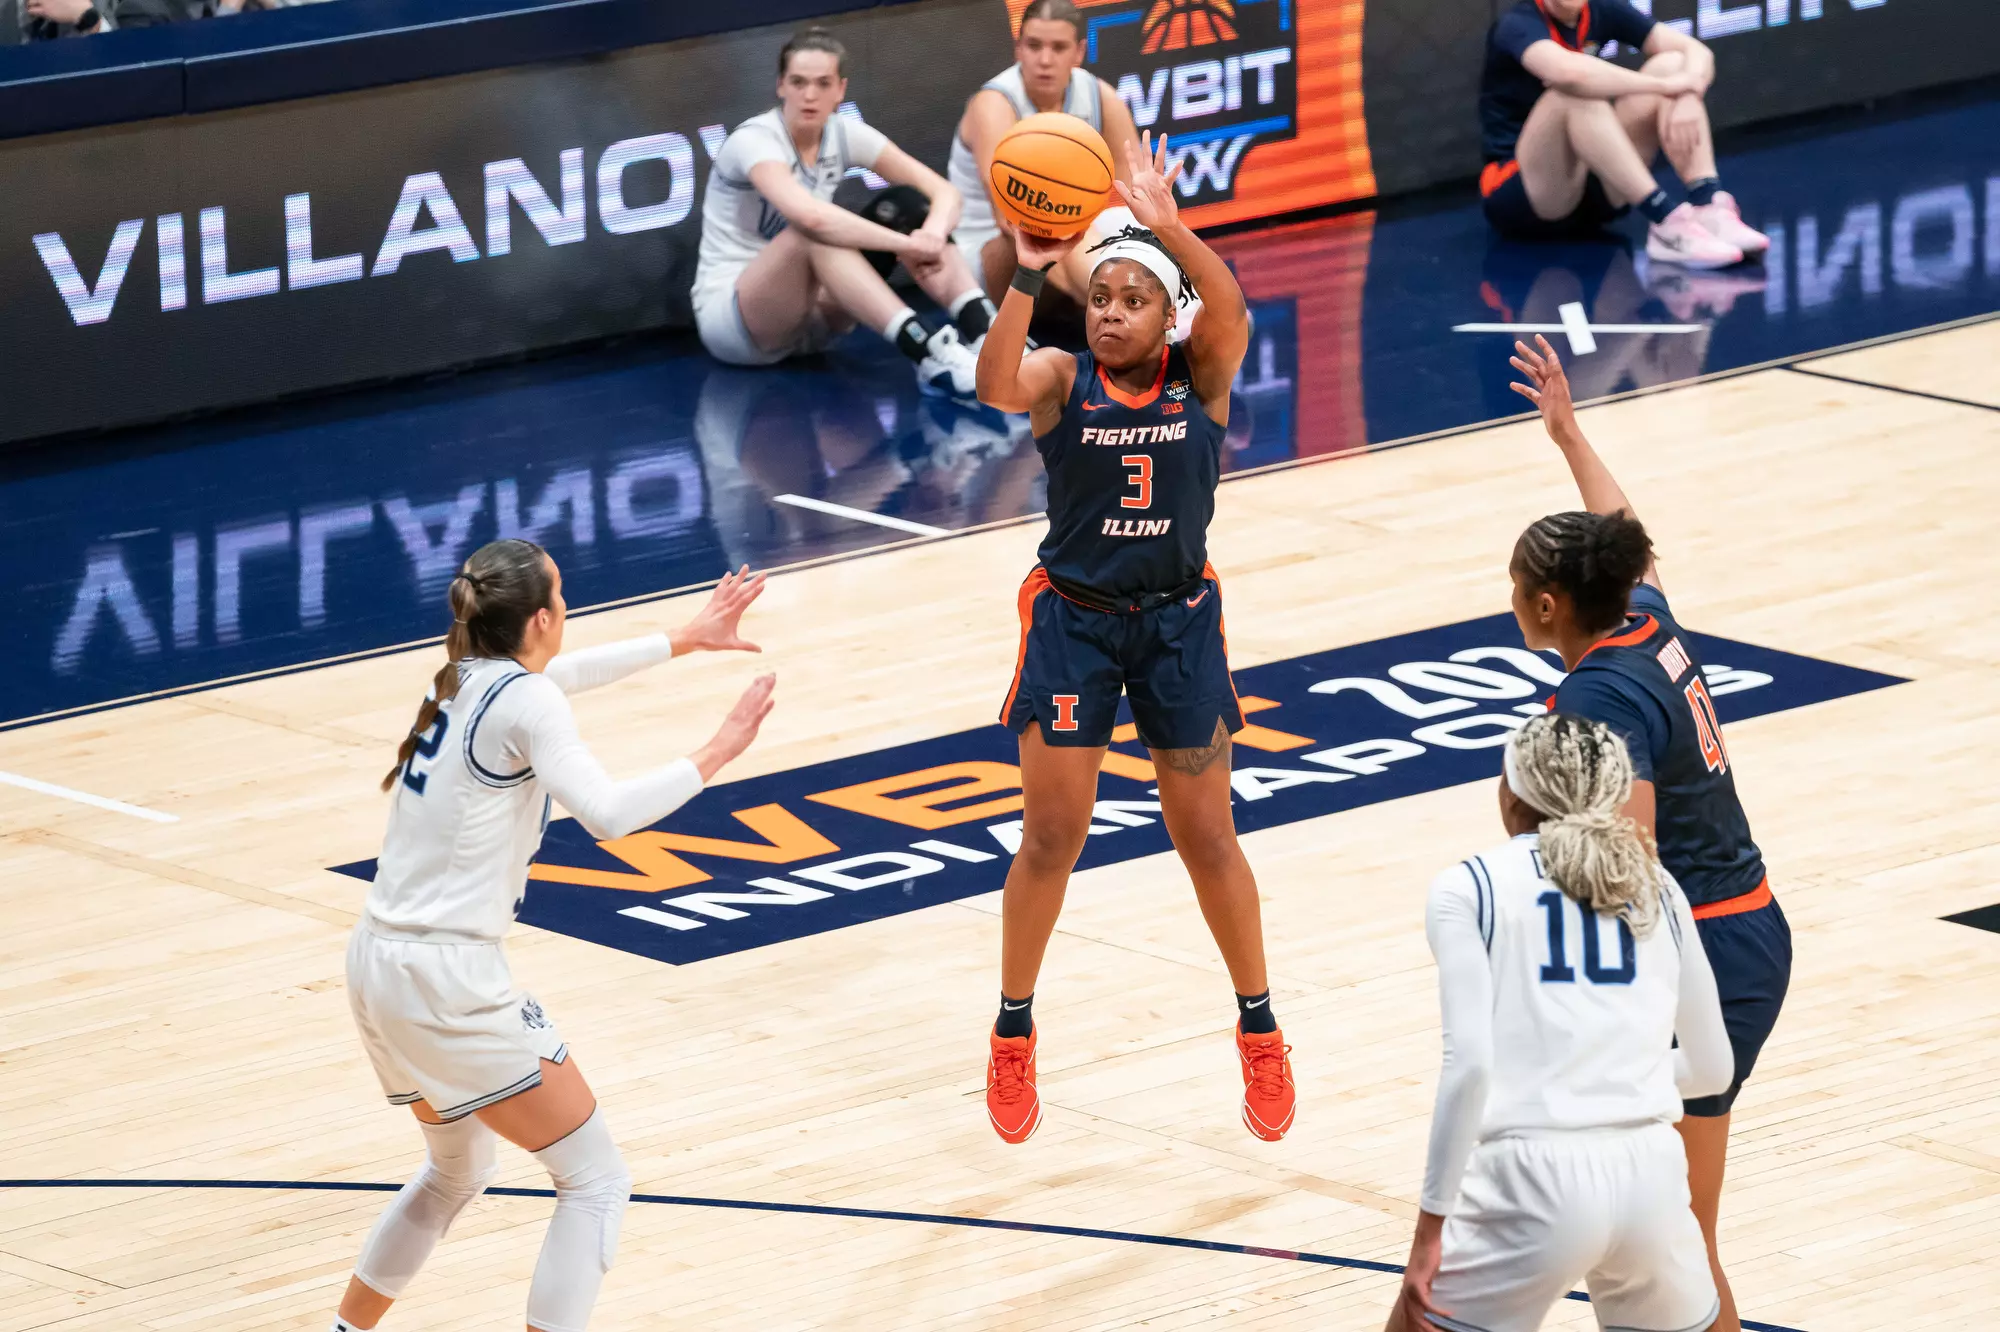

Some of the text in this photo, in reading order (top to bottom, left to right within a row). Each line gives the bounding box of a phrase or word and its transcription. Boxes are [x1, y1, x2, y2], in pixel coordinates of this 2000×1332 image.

[1117, 47, 1292, 126] WBIT
[32, 101, 892, 327] VILLANO
[1006, 174, 1082, 217] Wilson
[1166, 384, 1190, 396] WBIT
[1081, 420, 1188, 446] FIGHTING
[1121, 455, 1153, 509] 3
[1101, 518, 1172, 537] ILLINI
[1307, 646, 1568, 720] 202
[1052, 694, 1079, 731] I
[1536, 891, 1637, 985] 10
